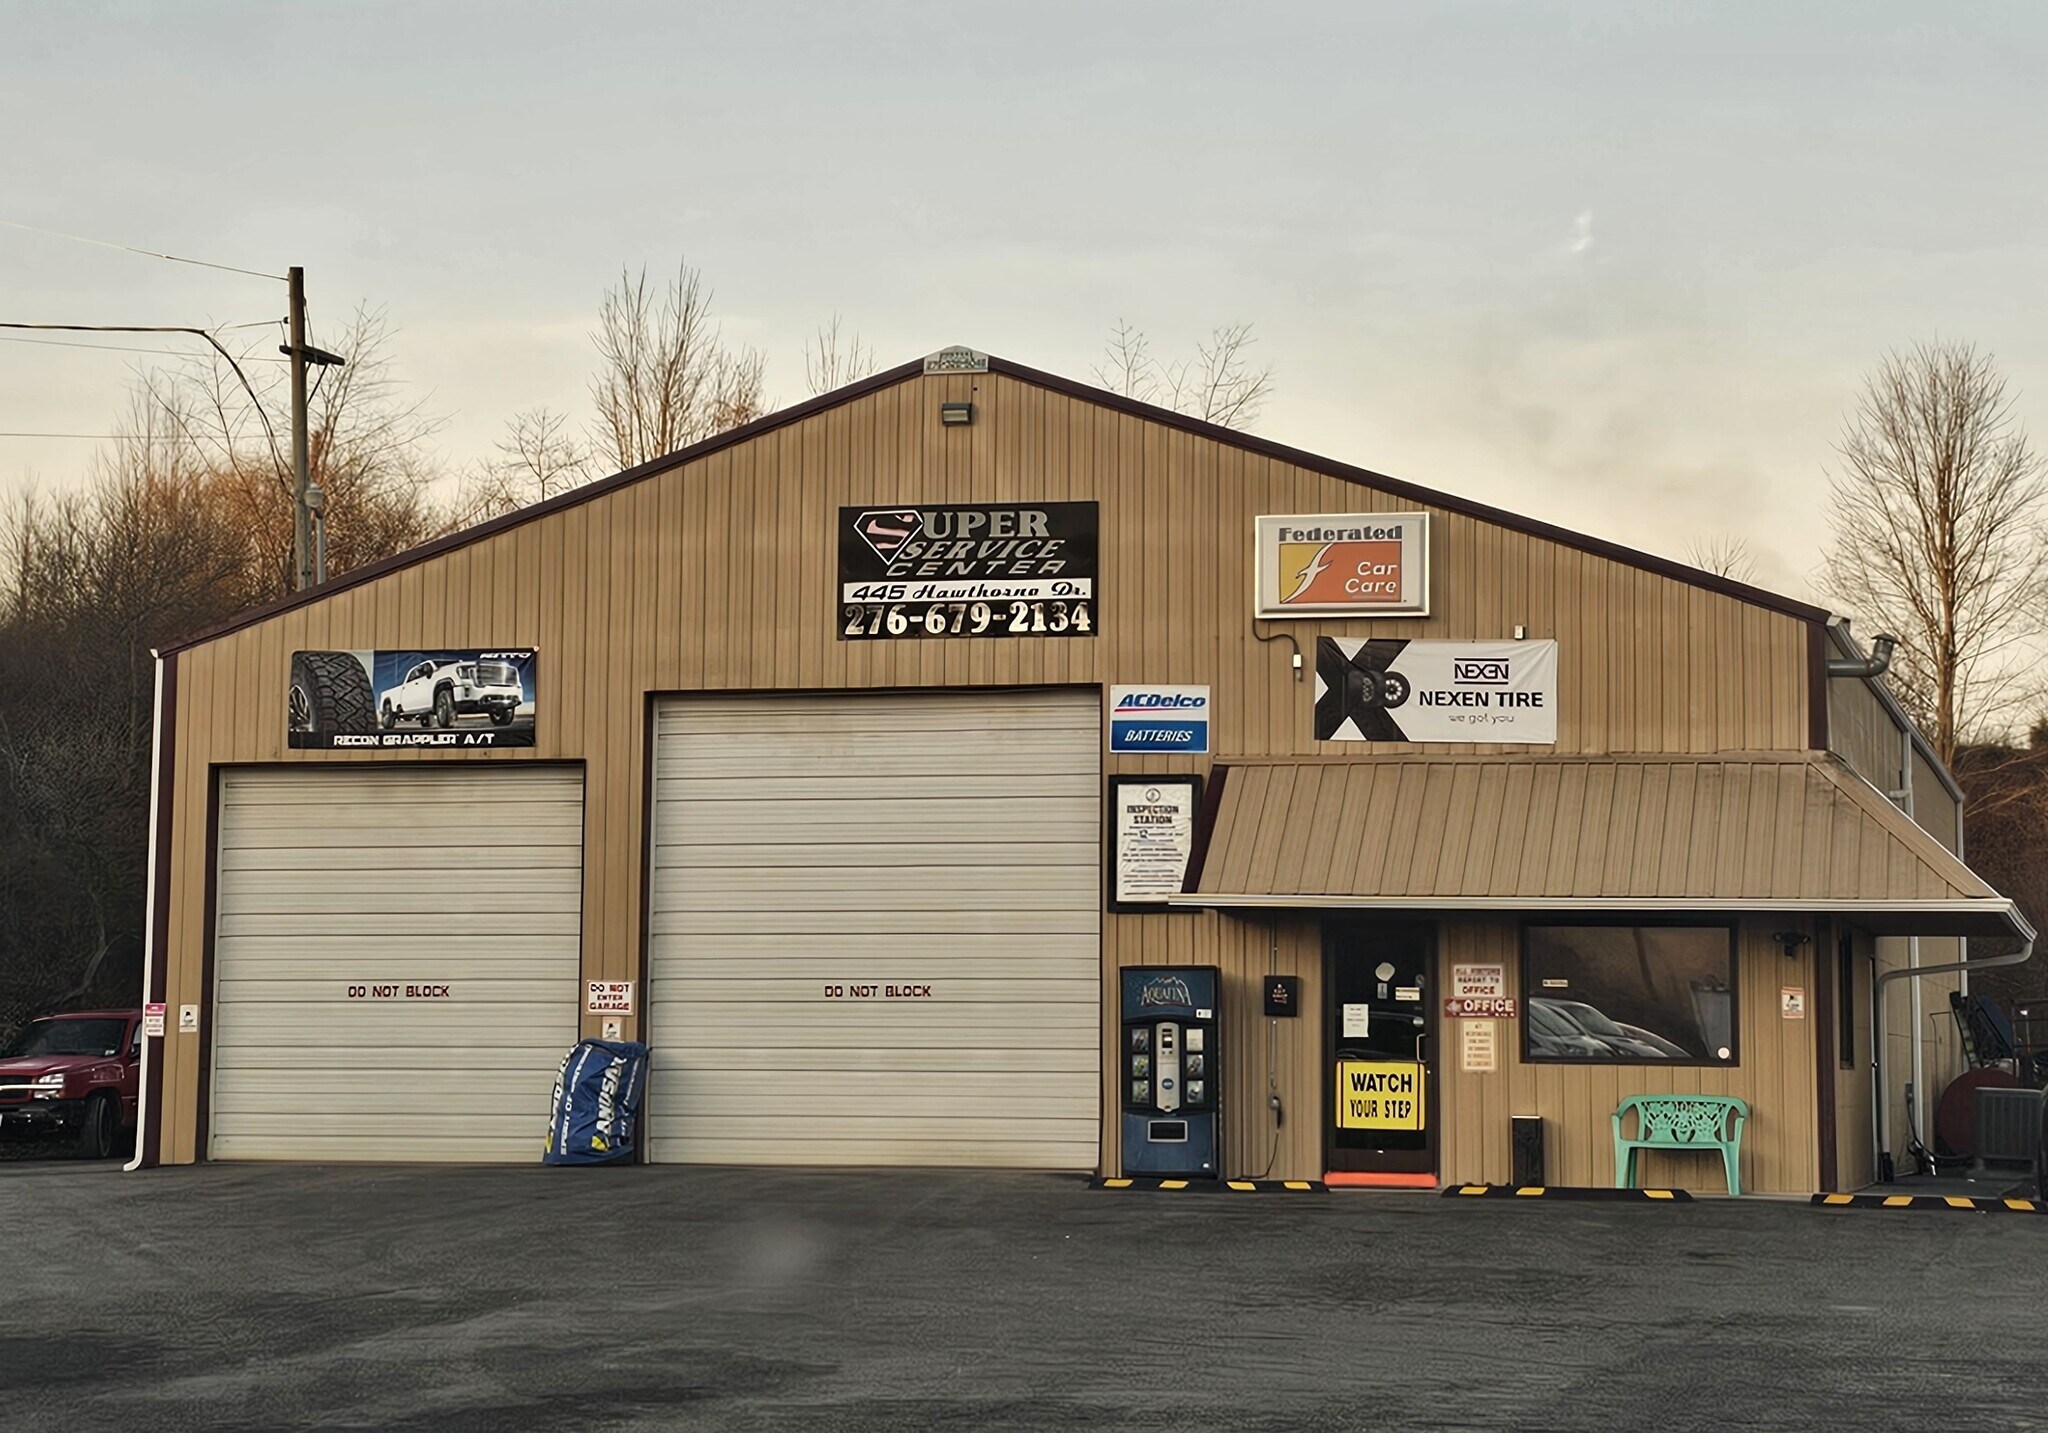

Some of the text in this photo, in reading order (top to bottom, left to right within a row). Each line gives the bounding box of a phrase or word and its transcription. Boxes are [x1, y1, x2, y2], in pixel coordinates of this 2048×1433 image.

[1279, 525, 1402, 541] Federated
[899, 539, 1065, 560] SERVICE
[1357, 562, 1397, 575] Car
[852, 581, 1086, 600] 445 Hawthorne Dr.
[1345, 578, 1396, 593] Care
[845, 601, 1091, 635] 276-679-2134
[1455, 664, 1508, 679] NEXEN
[1117, 694, 1206, 707] ACDelco
[1419, 691, 1543, 707] NEXEN TIRE
[333, 733, 495, 746] RECON GRAPPLER A/T
[1124, 729, 1194, 742] BATTERIES
[1127, 805, 1179, 814] INSPECTION
[1133, 816, 1173, 825] STATION
[348, 985, 450, 998] DO NOT BLOCK
[824, 985, 931, 998] DO NOT BLOCK
[1462, 986, 1495, 995] OFFICE
[1463, 999, 1515, 1012] OFFICE
[1351, 1073, 1412, 1093] WATCH
[1350, 1099, 1411, 1118] YOUR STEP
